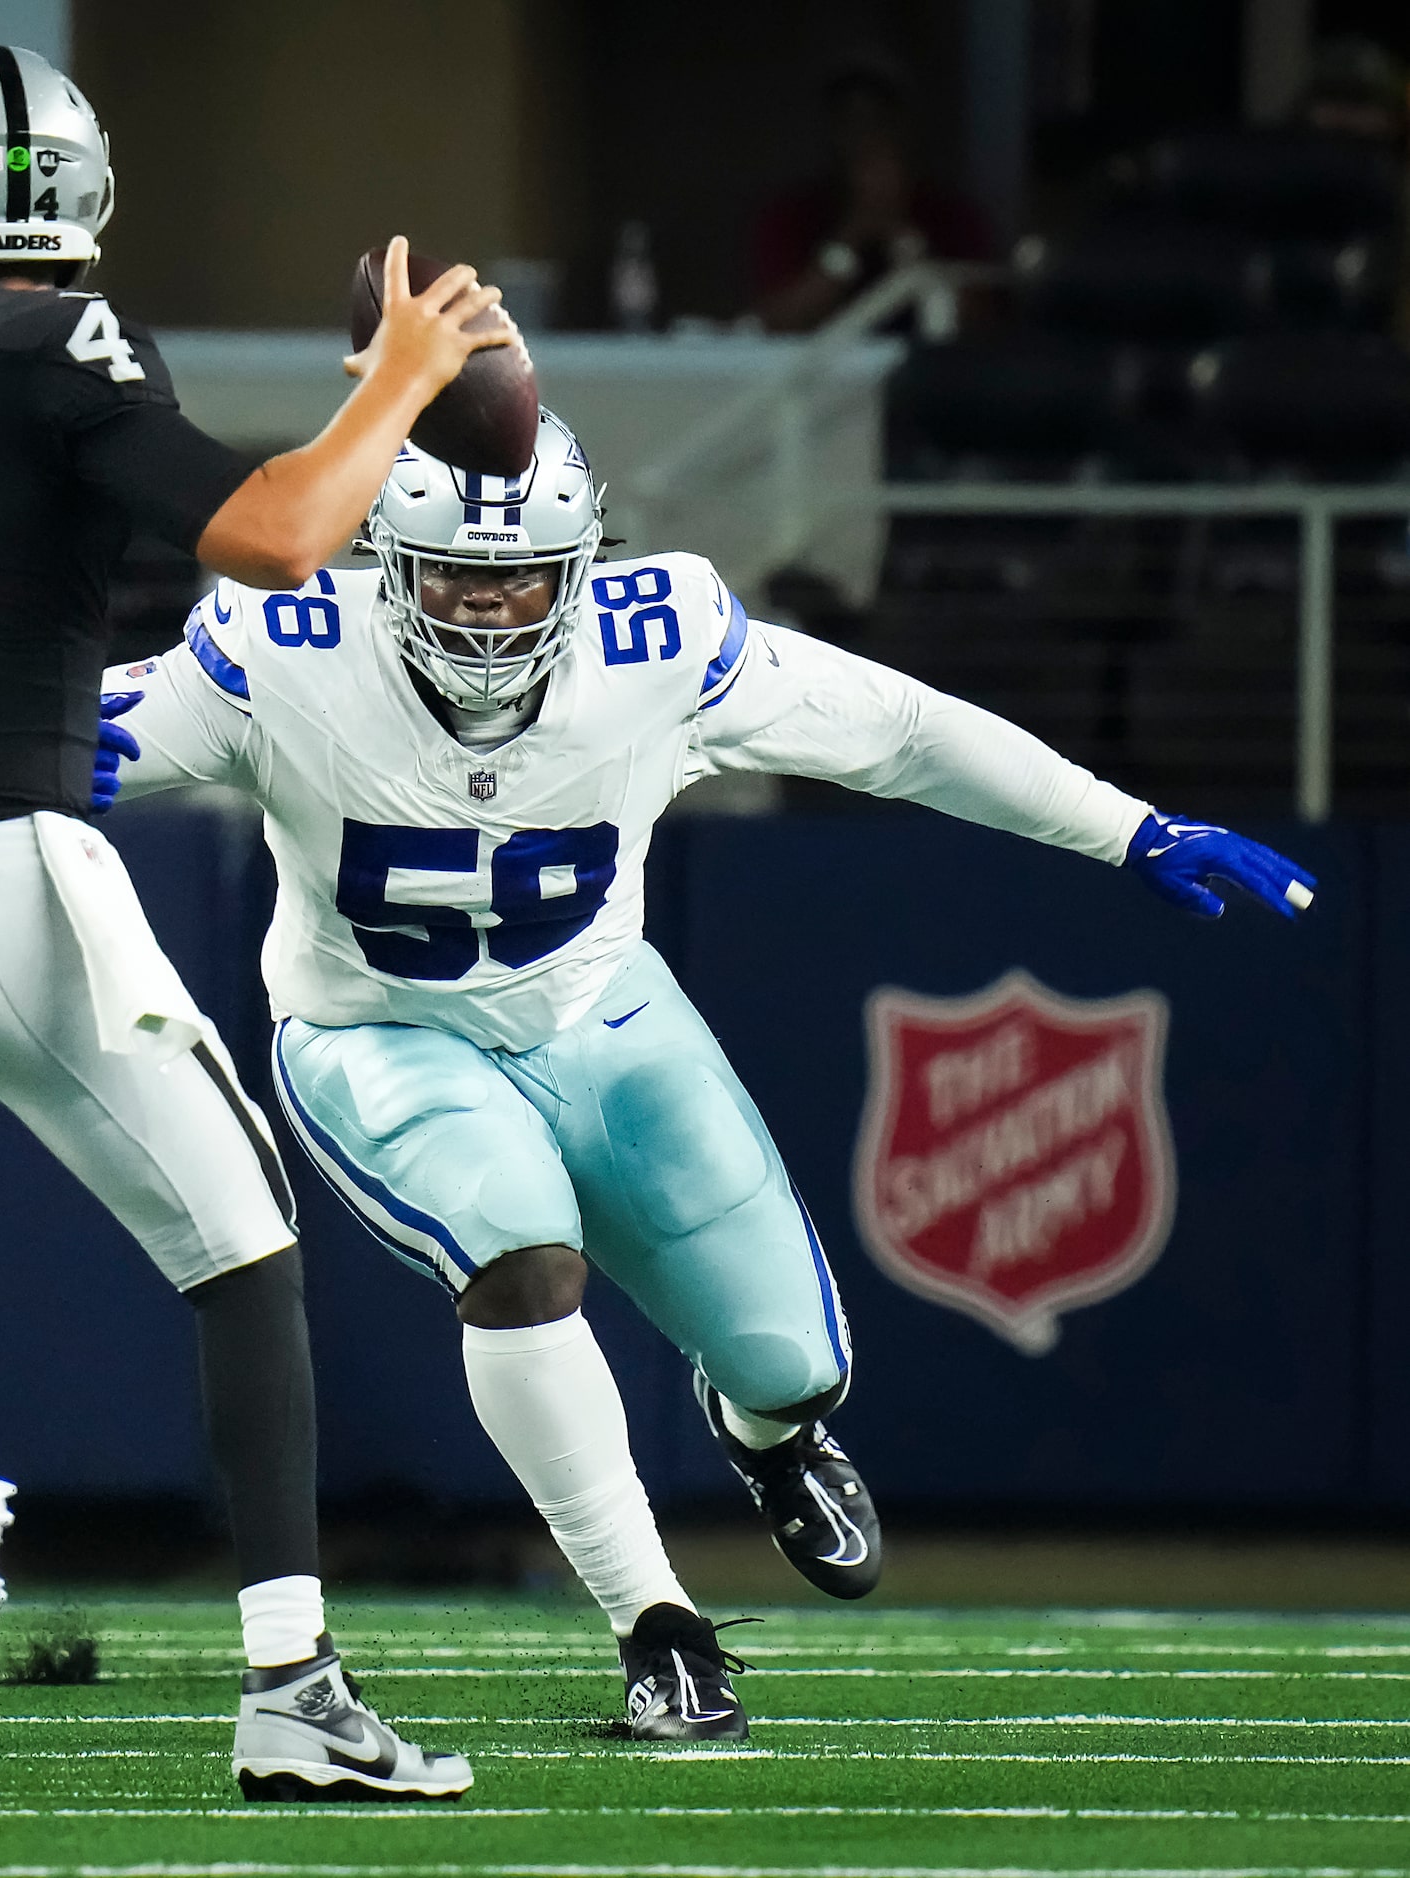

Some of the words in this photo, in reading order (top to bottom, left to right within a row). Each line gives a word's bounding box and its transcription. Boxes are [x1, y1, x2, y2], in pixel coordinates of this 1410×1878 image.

[33, 187, 60, 221] 4
[66, 299, 146, 383] 4
[467, 531, 518, 542] COWBOYS
[591, 567, 682, 667] 58
[474, 783, 493, 797] NFL
